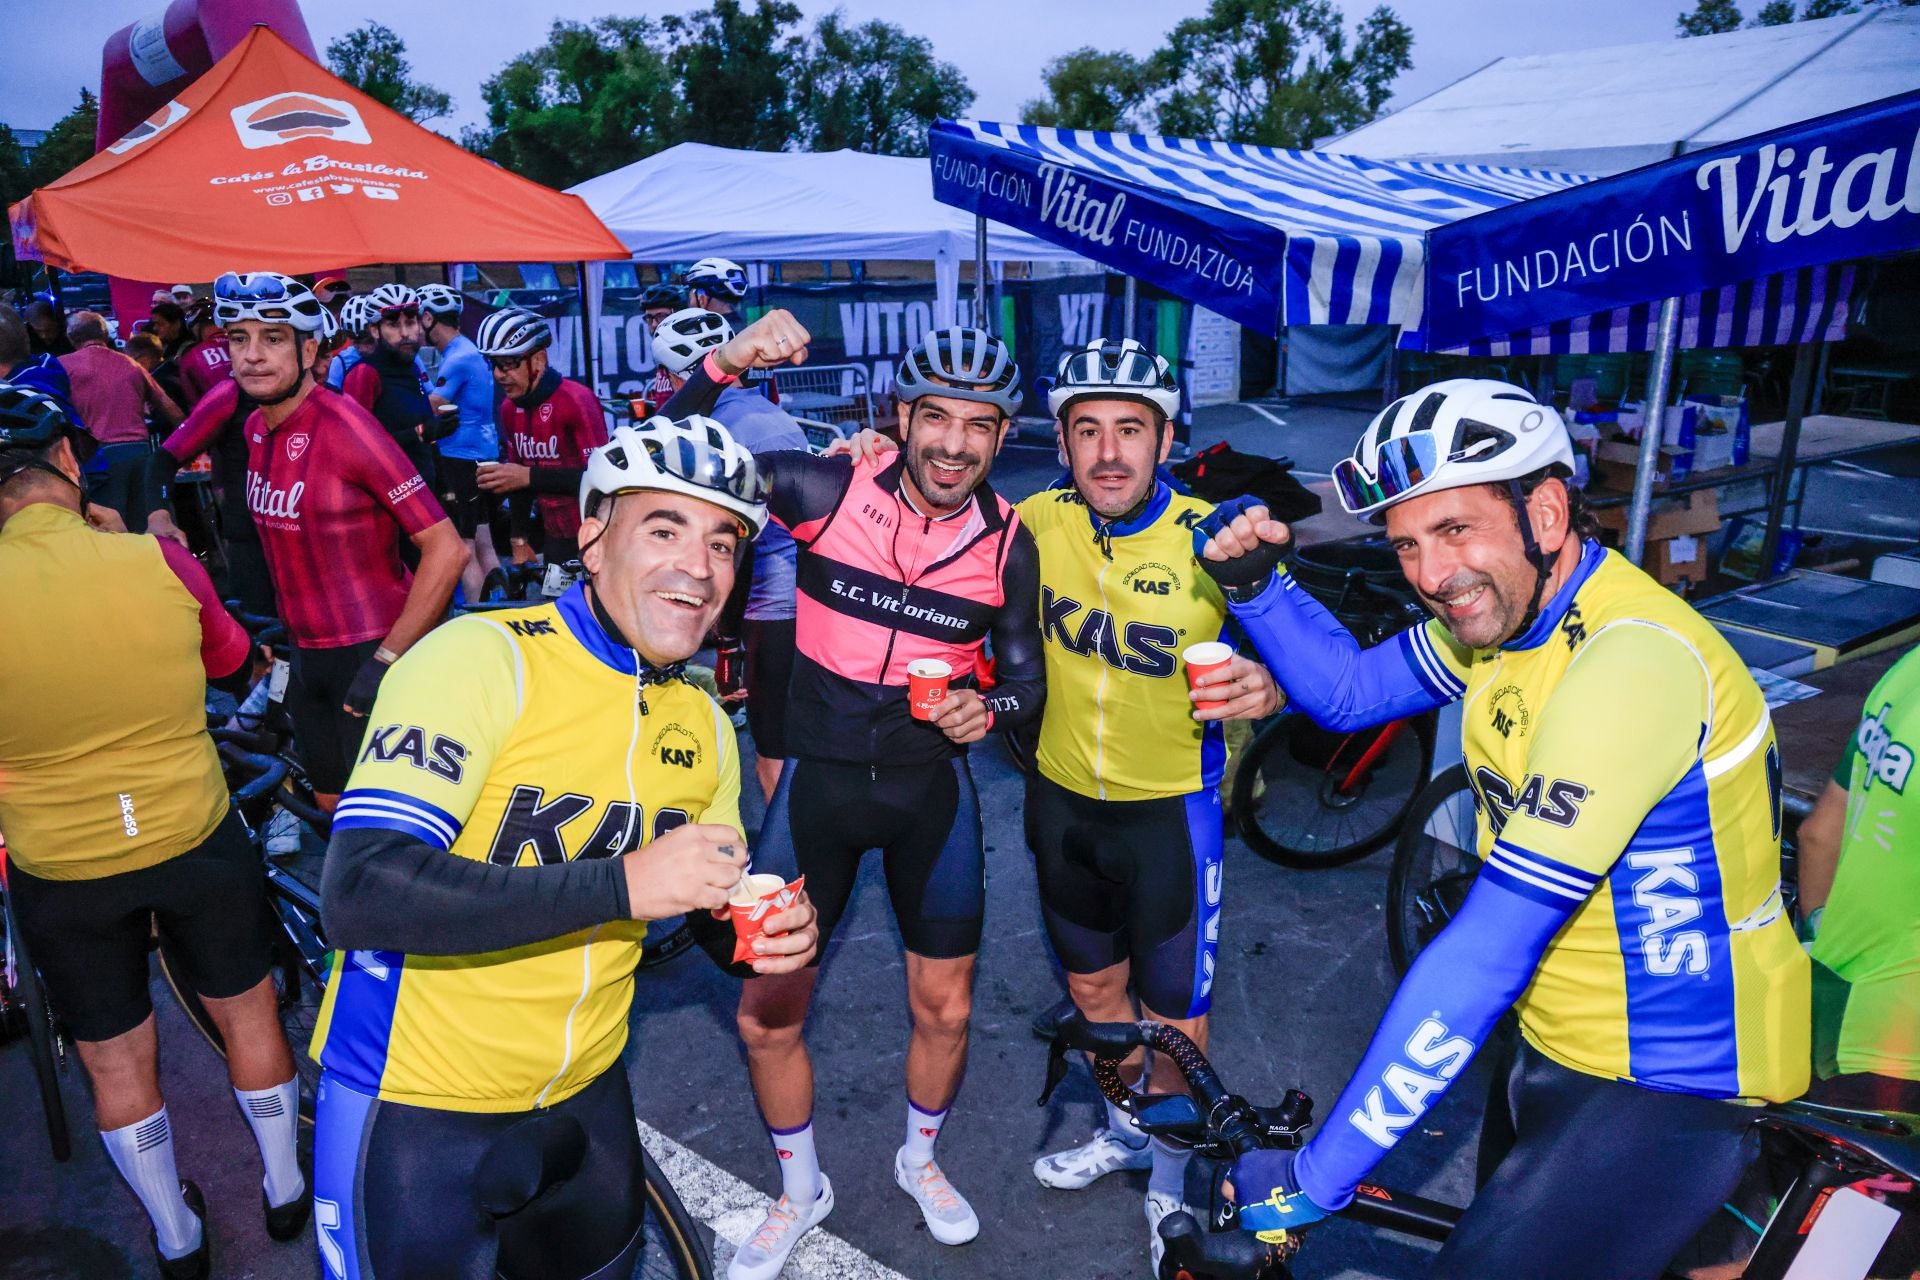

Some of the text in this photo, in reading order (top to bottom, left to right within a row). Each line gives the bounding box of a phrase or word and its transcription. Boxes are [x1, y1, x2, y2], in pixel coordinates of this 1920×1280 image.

[209, 155, 429, 185] Cafés la Brasileña
[934, 154, 1255, 296] FUNDACIÓN Vital FUNDAZIOA
[1457, 210, 1692, 307] FUNDACIÓN
[508, 326, 528, 346] MET
[514, 432, 560, 459] Vital
[246, 470, 305, 519] Vital
[830, 579, 970, 630] S.C. Vitoriana
[1133, 578, 1170, 595] KAS
[1041, 585, 1178, 678] KAS
[360, 724, 467, 785] KAS
[660, 746, 696, 769] KAS
[118, 793, 138, 837] GSPORT
[1512, 773, 1589, 828] AS
[1625, 846, 1711, 978] KAS
[1348, 1016, 1476, 1150] KAS
